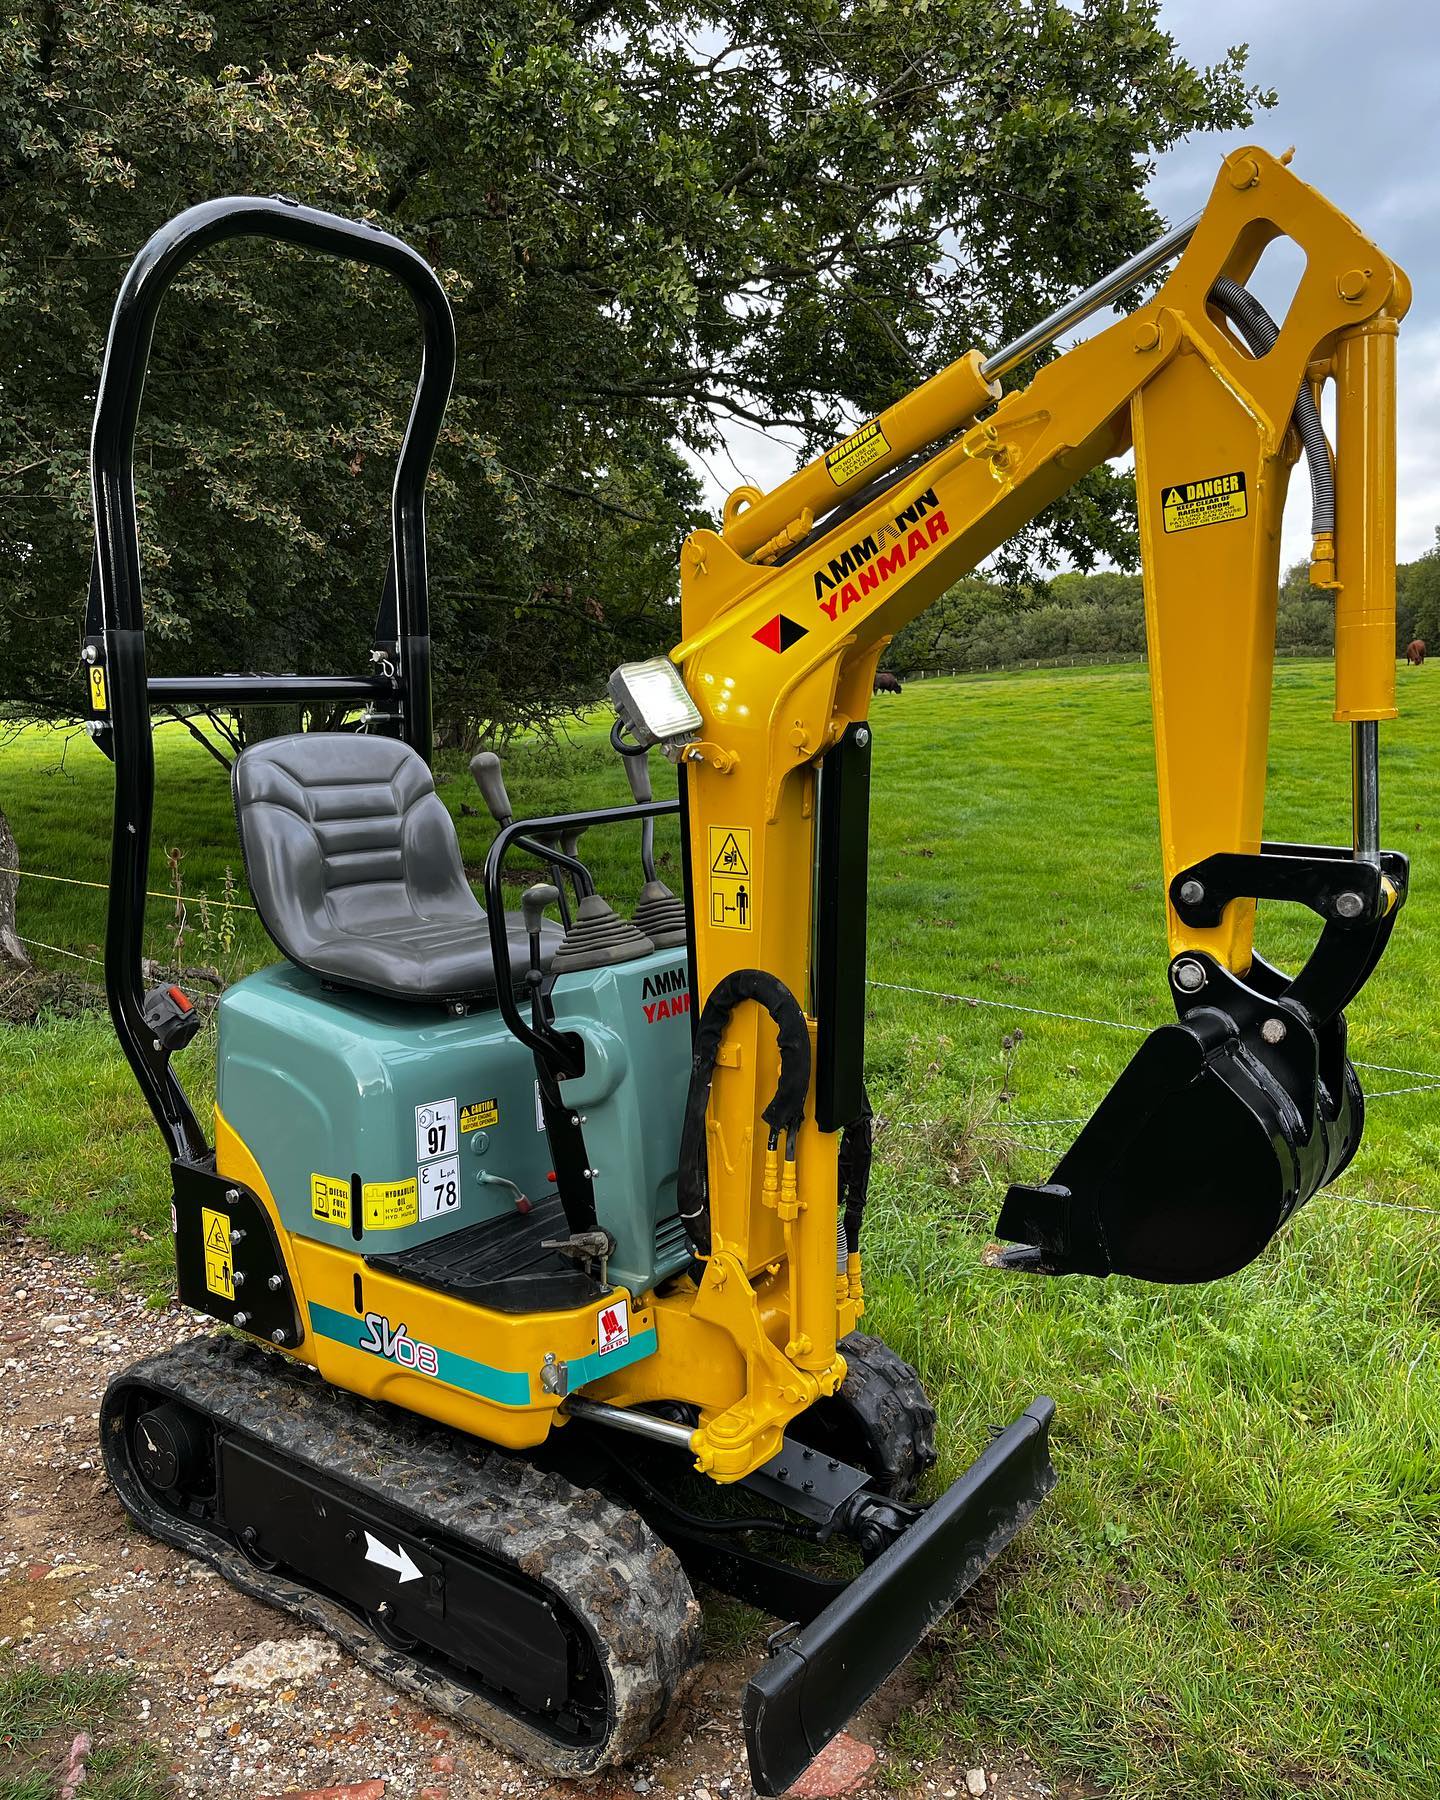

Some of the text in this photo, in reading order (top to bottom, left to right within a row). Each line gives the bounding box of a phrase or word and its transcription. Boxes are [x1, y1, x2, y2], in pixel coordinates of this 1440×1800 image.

[829, 424, 877, 464] WARNING
[843, 456, 855, 466] NOT
[855, 447, 867, 458] USE
[868, 438, 880, 449] THIS
[842, 447, 876, 472] EXCAVATOR
[859, 451, 878, 467] CRANE
[1186, 475, 1239, 500] DANGER
[1177, 503, 1194, 511] KEEP
[1196, 498, 1219, 507] CLEAR
[1178, 501, 1230, 516] RAISED BOOM
[813, 487, 941, 601] AMMANN
[819, 510, 950, 622] YANMAR
[642, 967, 687, 1000] AMM
[642, 992, 690, 1024] YAN
[471, 1099, 494, 1115] CAUTION
[428, 1125, 447, 1154] 97
[329, 1187, 348, 1200] DIESEL
[332, 1198, 346, 1209] FUEL
[385, 1185, 415, 1198] HYDRAULIC
[397, 1198, 406, 1206] OIL
[433, 1181, 457, 1211] 78
[332, 1209, 346, 1219] ONLY
[359, 1311, 439, 1377] SV08
[601, 1344, 614, 1354] MAX
